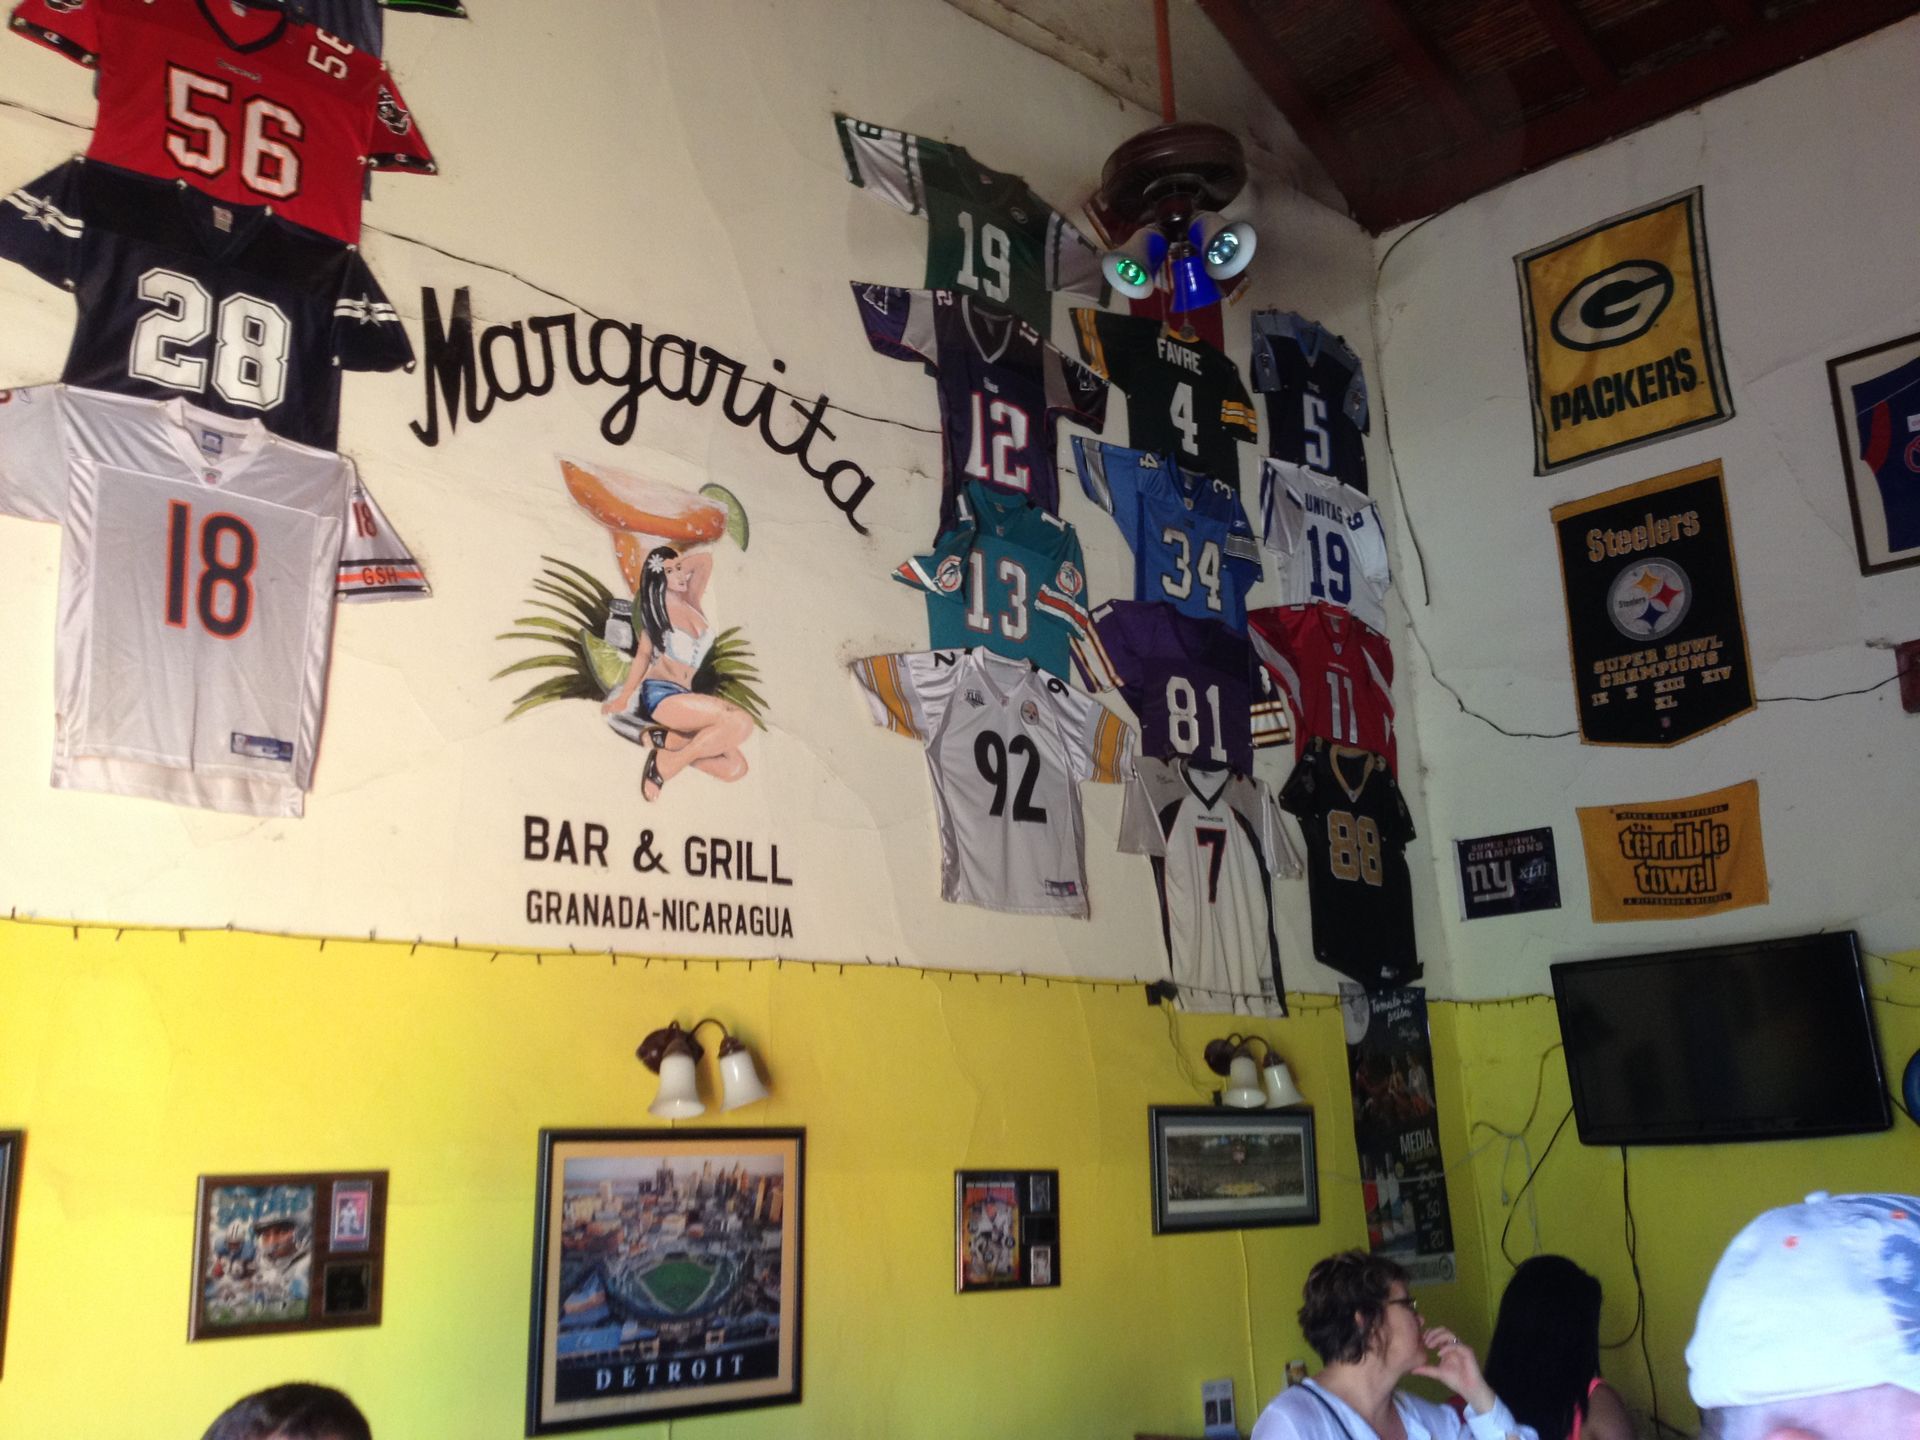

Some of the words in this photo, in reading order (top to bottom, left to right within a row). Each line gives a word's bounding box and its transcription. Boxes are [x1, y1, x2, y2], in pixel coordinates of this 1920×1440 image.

[166, 62, 304, 199] 56
[957, 211, 1010, 303] 19
[129, 267, 291, 410] 28
[1157, 337, 1202, 376] FAVRE
[409, 285, 875, 536] Margarita
[1169, 381, 1199, 456] 4
[1550, 347, 1698, 432] PACKERS
[964, 391, 1029, 493] 12
[1303, 393, 1332, 471] 5
[352, 502, 378, 538] 18
[1304, 492, 1343, 525] UNITAS
[1586, 510, 1700, 563] Steelers
[165, 499, 258, 640] 18
[361, 567, 399, 587] GSH
[965, 549, 1029, 642] 13
[1161, 527, 1223, 613] 34
[1306, 524, 1351, 604] 19
[1593, 648, 1659, 675] SUPER
[1664, 635, 1723, 660] BOWL
[1600, 651, 1720, 689] CHAMPIONS
[1166, 676, 1228, 762] 81
[1326, 671, 1358, 745] 11
[974, 730, 1048, 824] 92
[524, 815, 610, 868] BAR
[633, 829, 671, 874] &
[684, 835, 793, 887] GRILL
[1196, 827, 1228, 903] 7
[1327, 809, 1383, 887] 88
[1467, 841, 1544, 862] CHAMPIONS
[1618, 818, 1730, 861] terrible
[1634, 854, 1718, 895] towel
[526, 889, 794, 939] GRANADA-NICARAGUA
[1399, 1127, 1434, 1154] MEDIA
[595, 1353, 745, 1391] DETROIT
